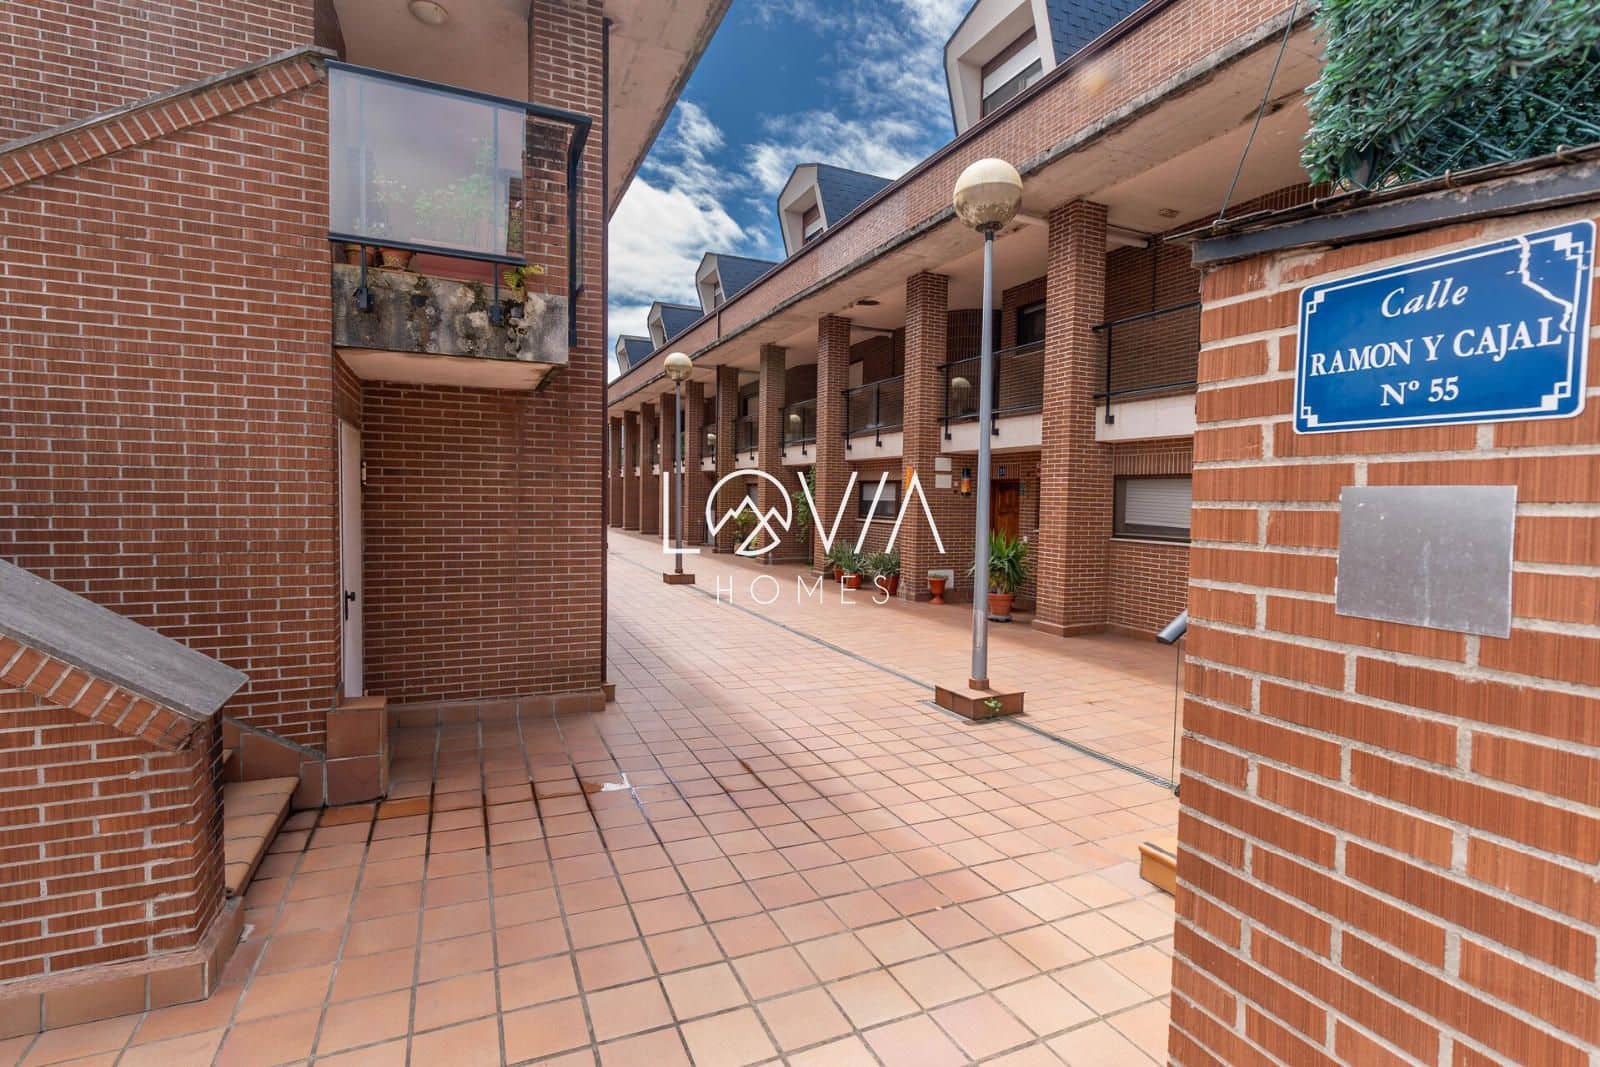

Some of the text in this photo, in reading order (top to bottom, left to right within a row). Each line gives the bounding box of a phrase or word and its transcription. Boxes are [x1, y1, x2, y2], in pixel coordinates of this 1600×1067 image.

[1381, 277, 1469, 318] Calle
[1310, 317, 1562, 377] RAMON Y CAJAL
[1427, 376, 1460, 402] 55
